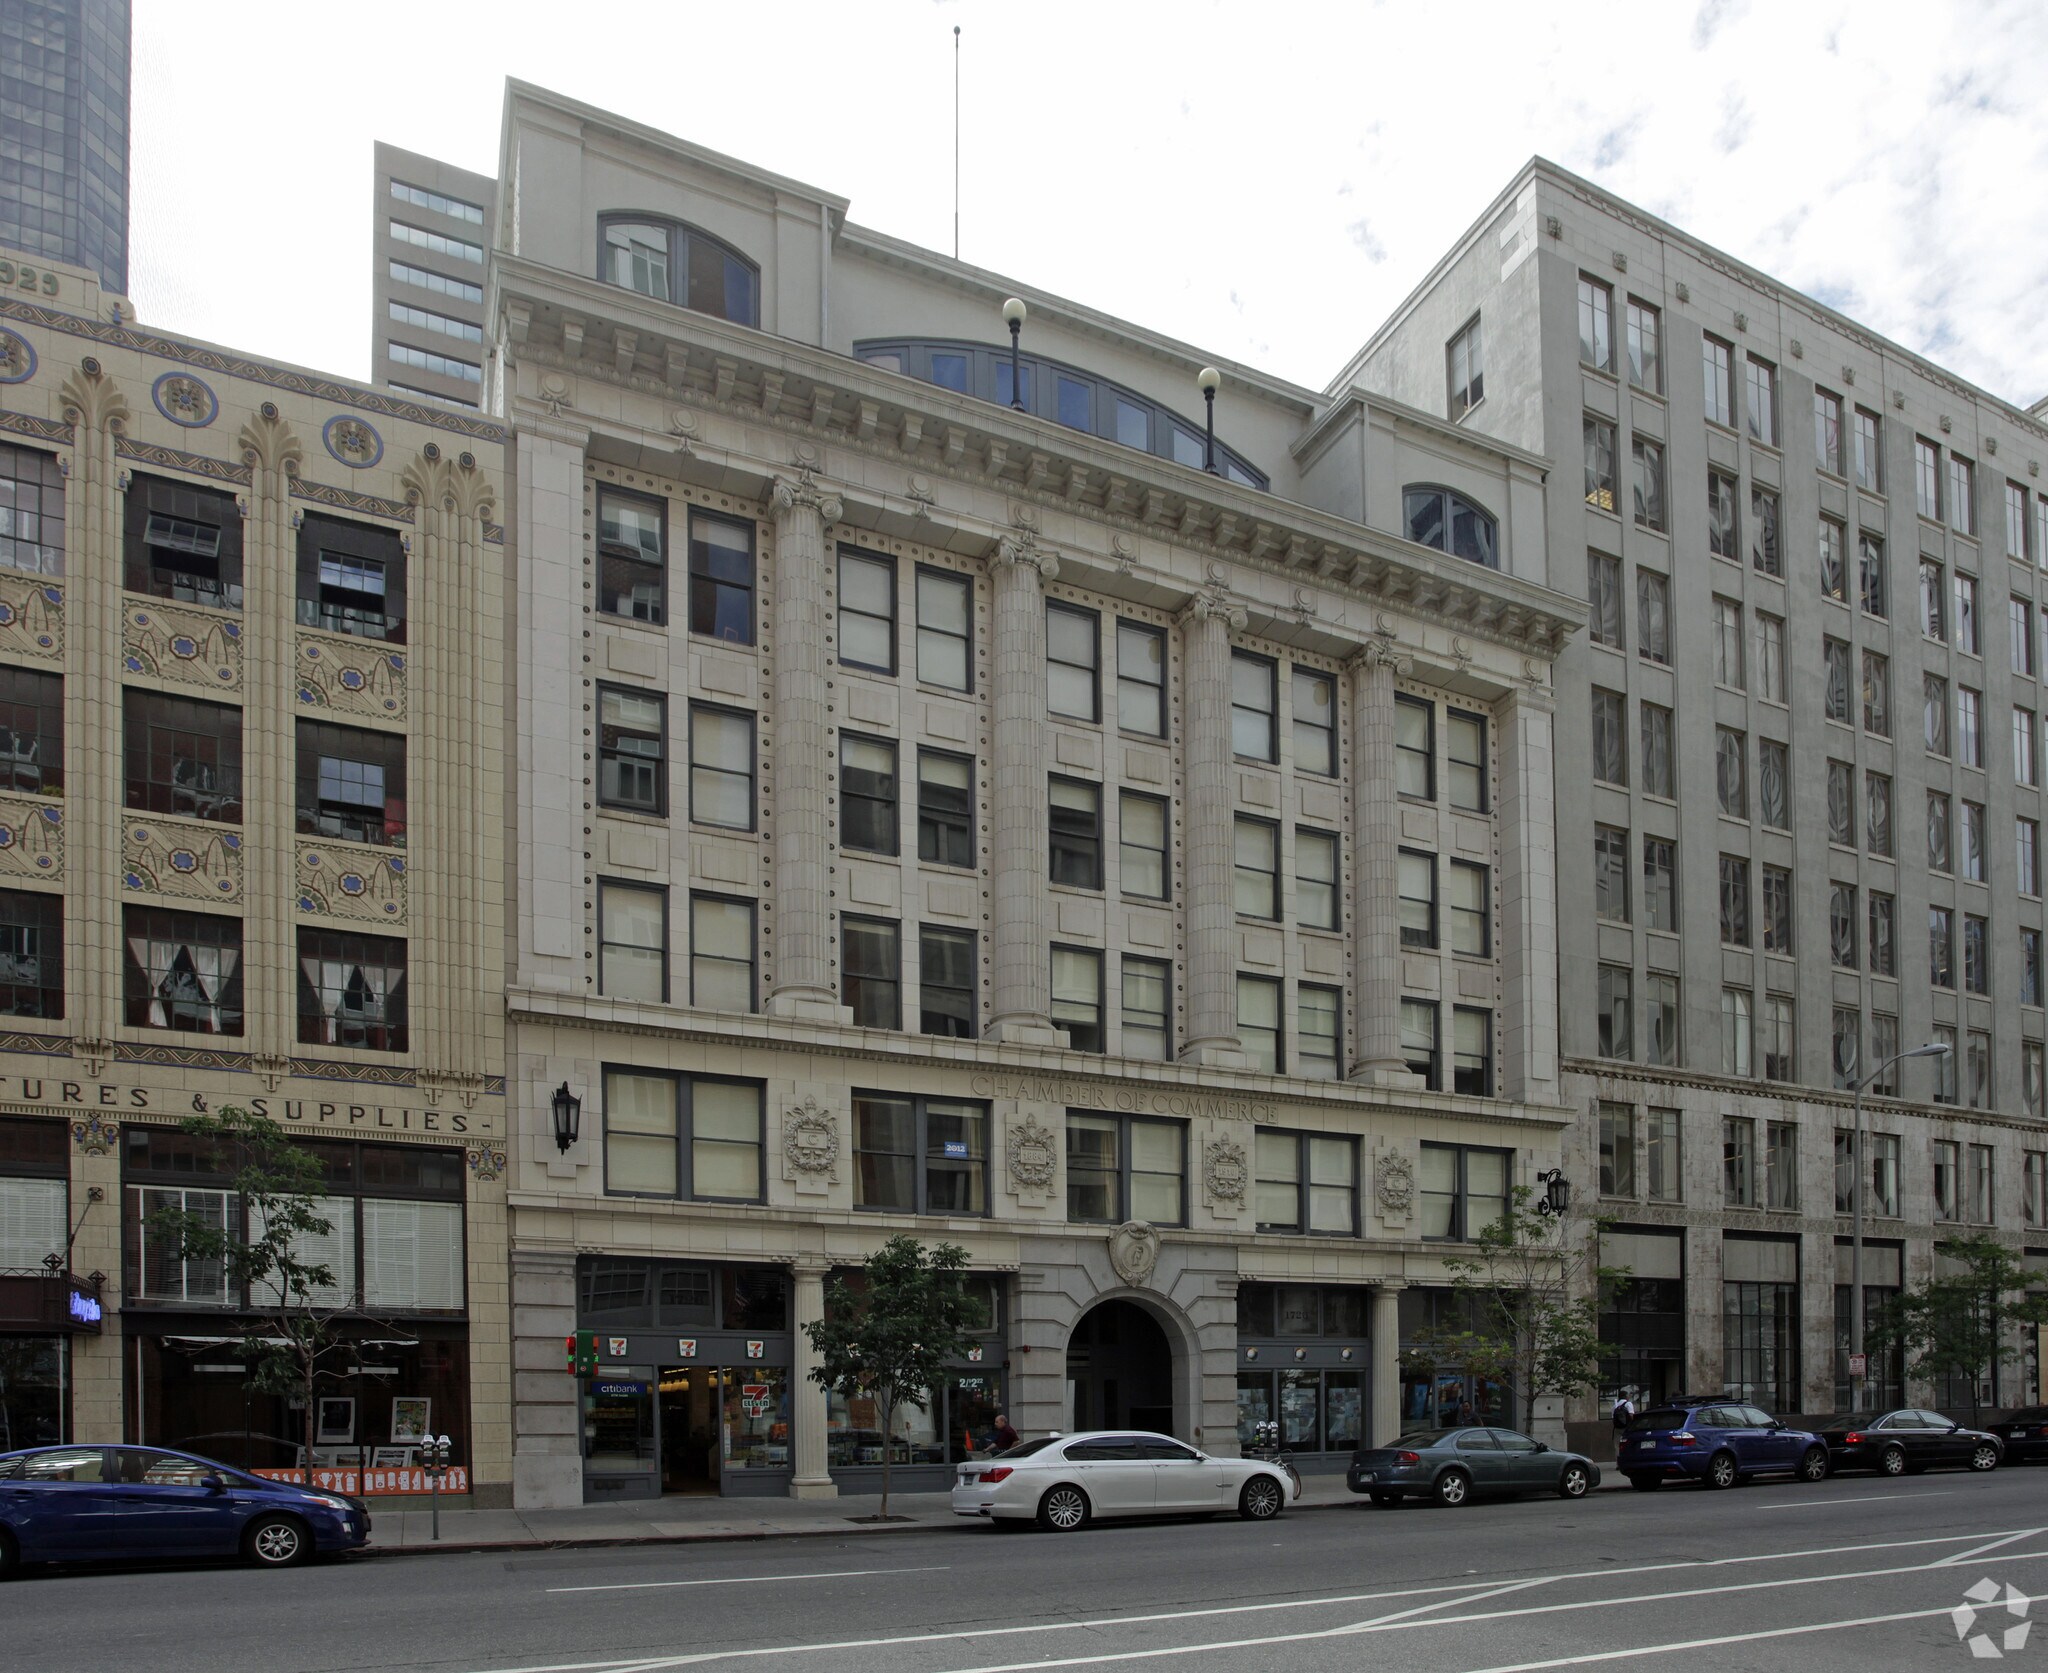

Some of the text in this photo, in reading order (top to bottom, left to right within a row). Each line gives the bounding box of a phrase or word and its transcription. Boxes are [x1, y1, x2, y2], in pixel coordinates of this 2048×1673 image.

[192, 1093, 208, 1113] &
[970, 1075, 1278, 1124] CHAMBER OF COMMERCE
[946, 1144, 966, 1153] 2012
[600, 1384, 638, 1393] citibank
[743, 1385, 769, 1417] 7
